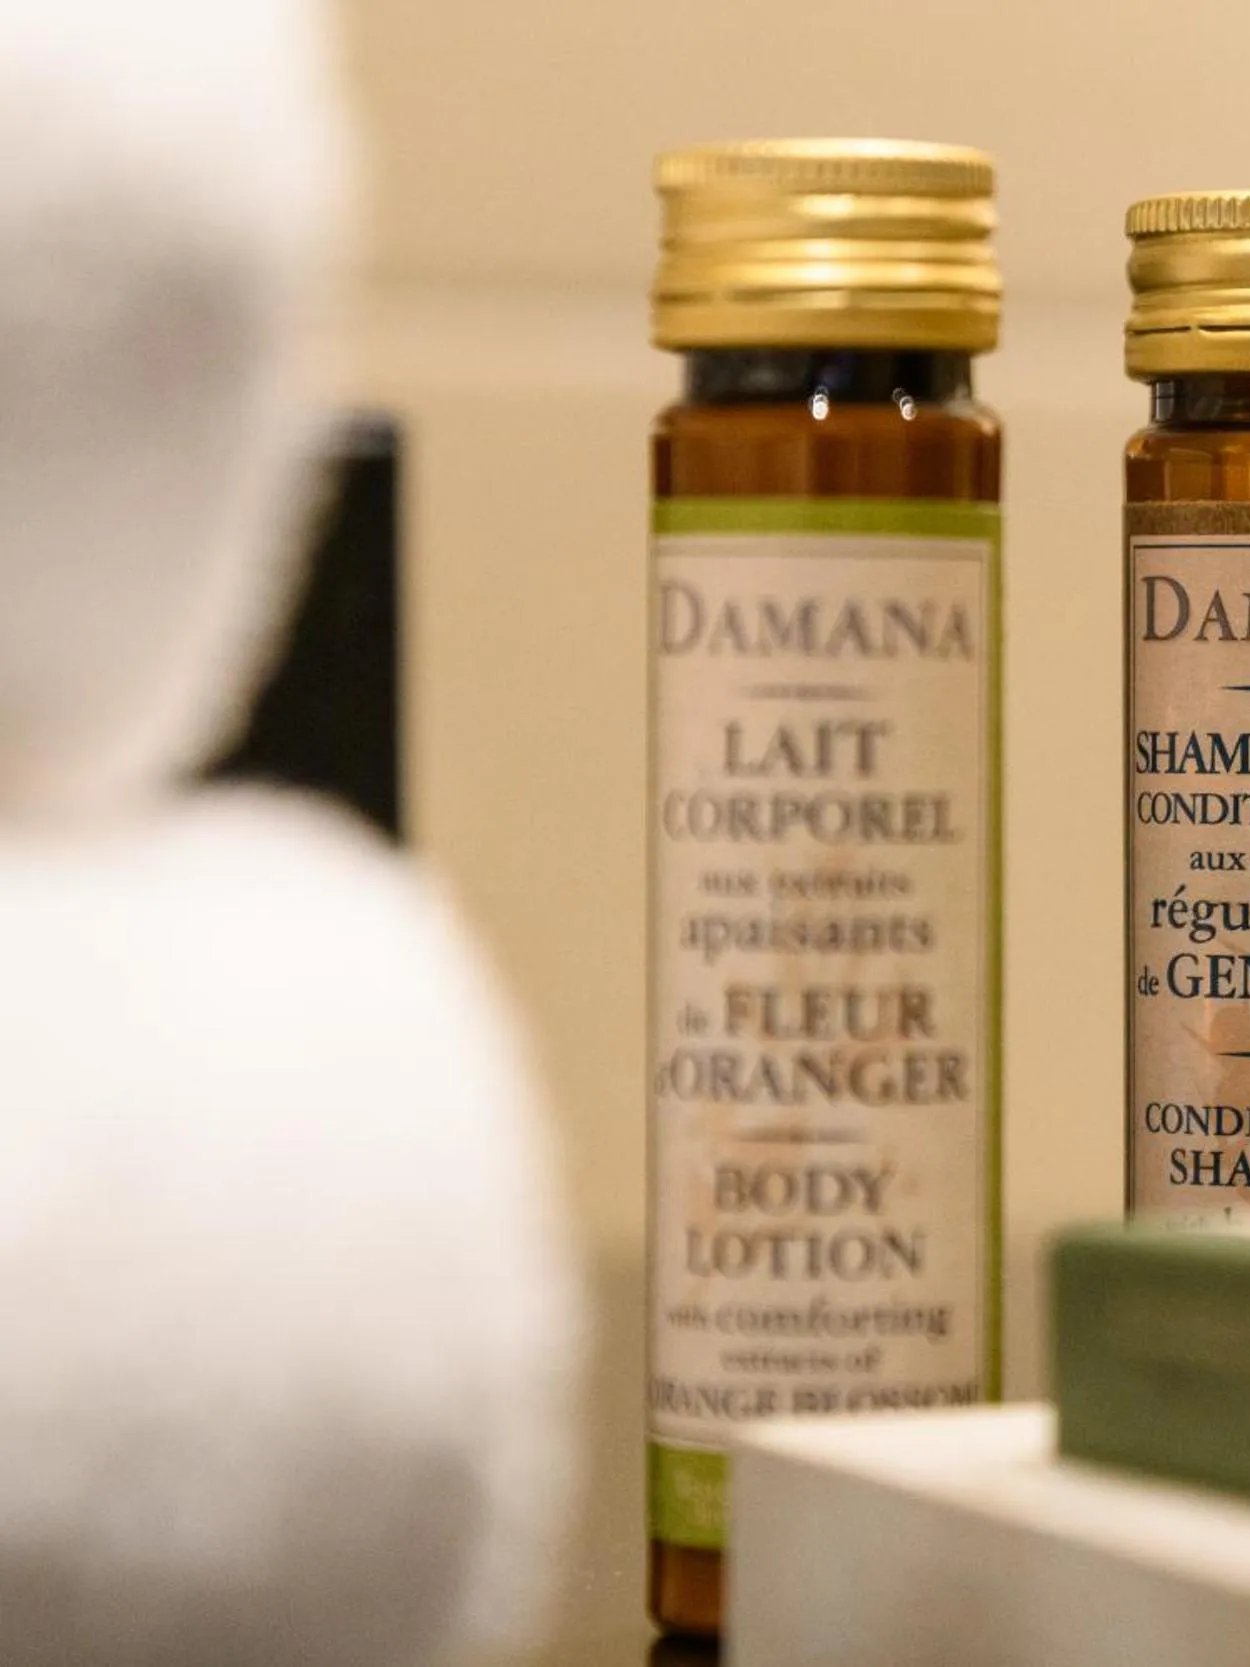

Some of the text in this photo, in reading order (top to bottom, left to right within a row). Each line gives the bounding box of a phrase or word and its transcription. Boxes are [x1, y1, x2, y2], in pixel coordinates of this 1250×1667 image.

[659, 579, 975, 660] DAMANA
[722, 718, 888, 778] LAIT
[662, 789, 958, 845] CORPOREL
[1189, 850, 1246, 872] aux
[1138, 965, 1160, 996] de
[723, 982, 937, 1041] FLEUR
[714, 1160, 893, 1216] BODY
[687, 1226, 927, 1281] LOTION
